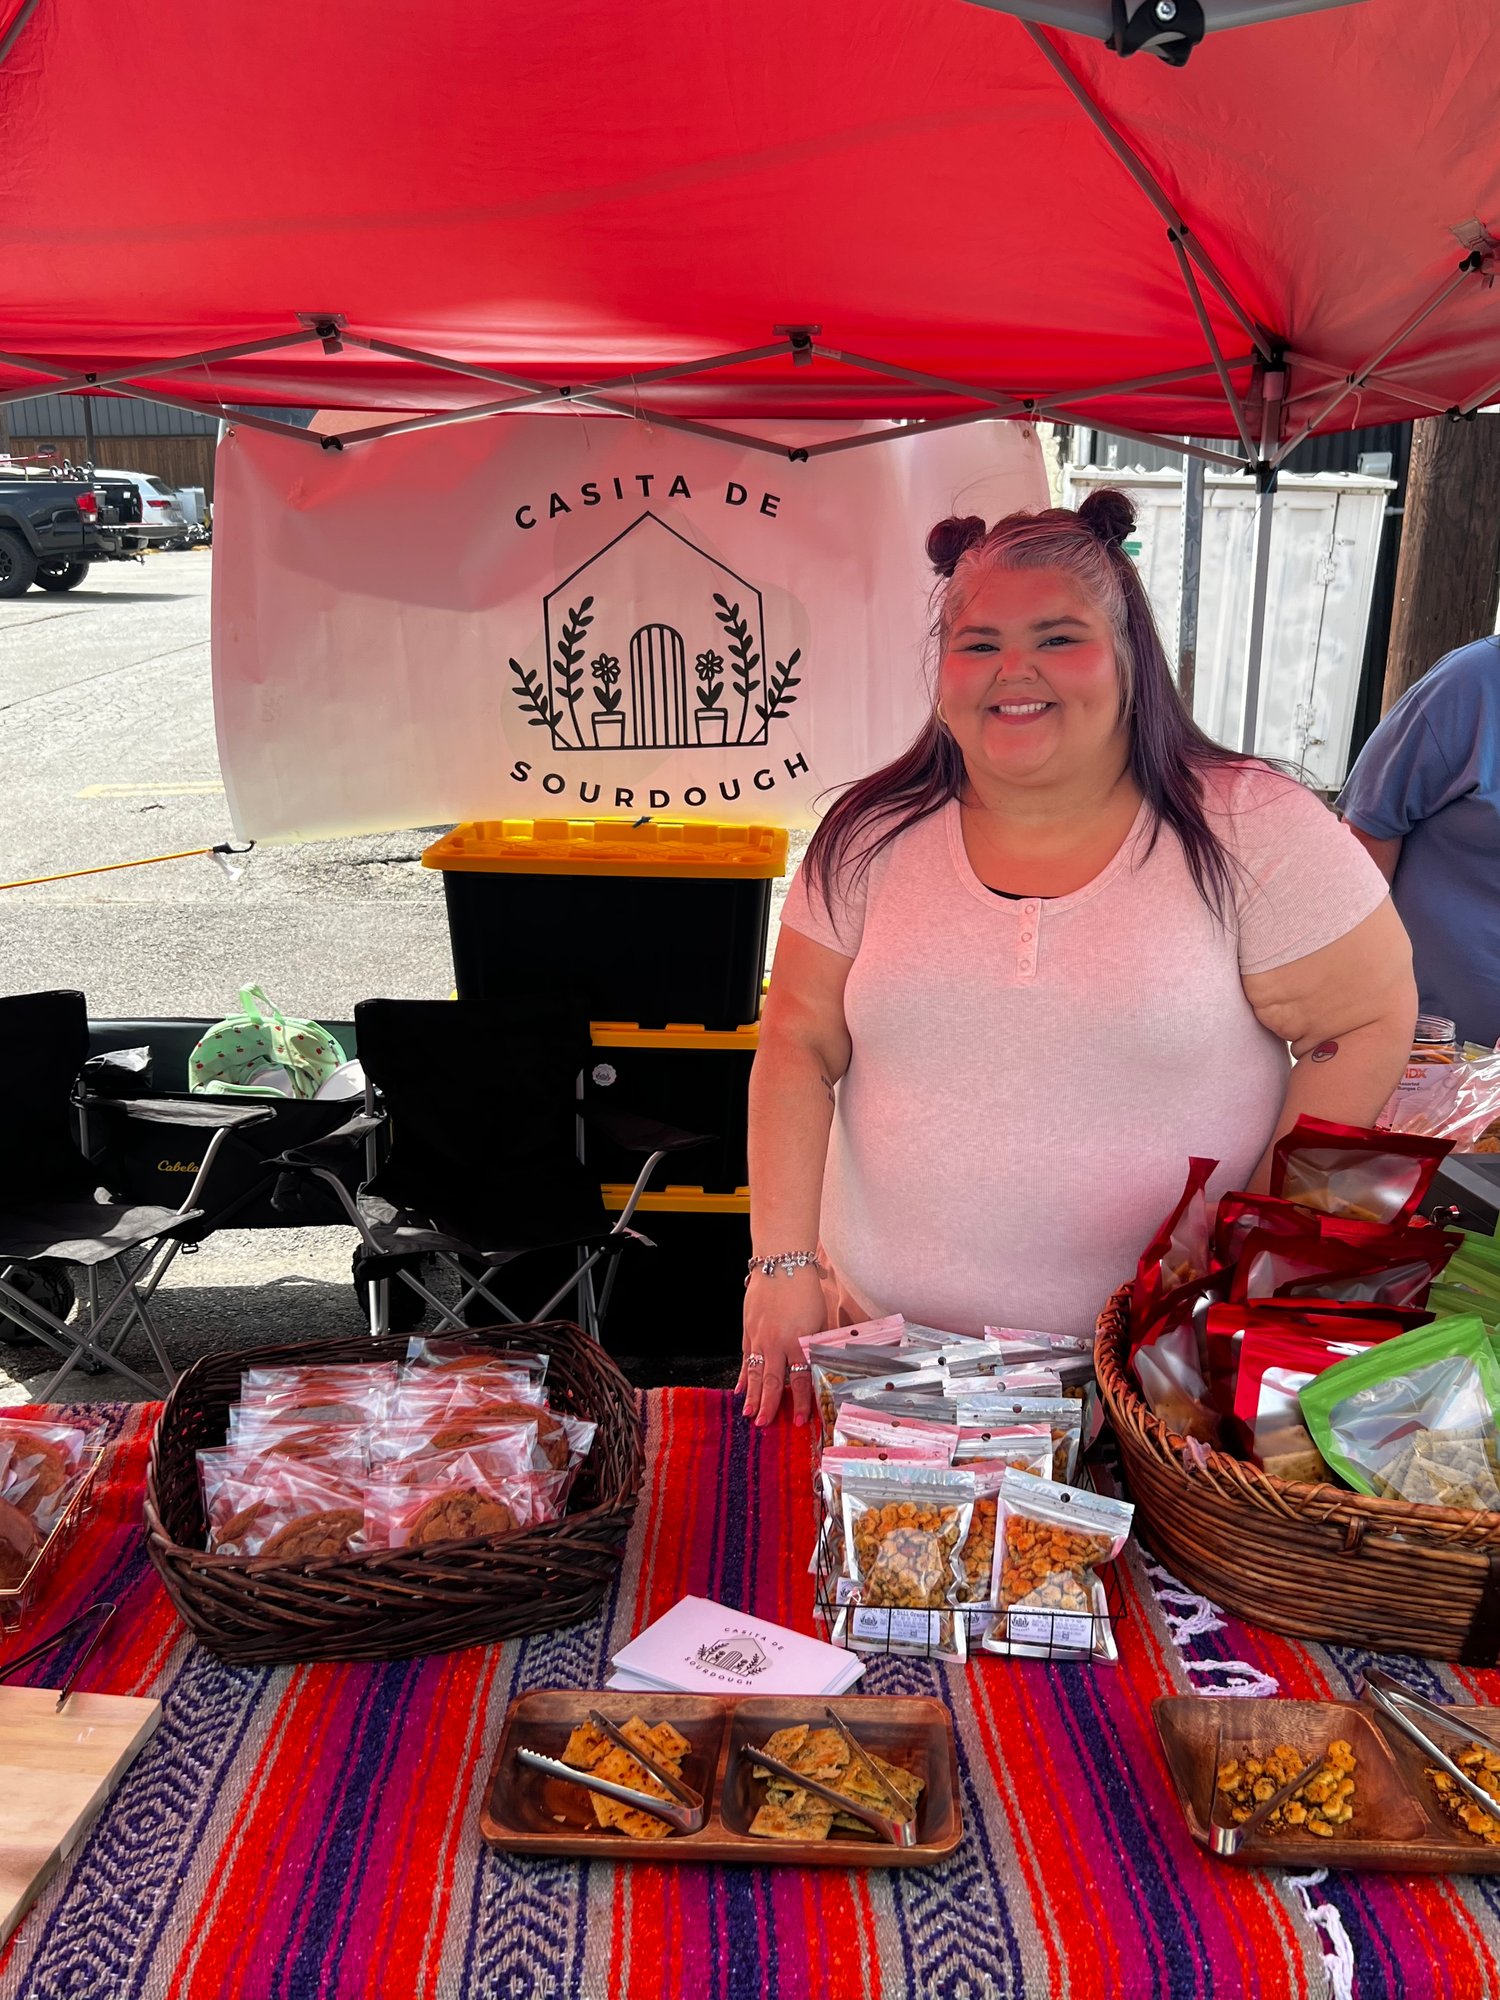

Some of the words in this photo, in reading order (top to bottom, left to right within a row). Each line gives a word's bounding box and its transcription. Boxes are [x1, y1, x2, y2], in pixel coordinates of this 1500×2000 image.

[515, 474, 692, 529] CASITA
[725, 482, 781, 518] DE
[509, 752, 810, 809] SOURDOUGH
[724, 1627, 767, 1641] CASITA
[771, 1641, 784, 1651] DE
[684, 1656, 752, 1685] SOURDOUGH
